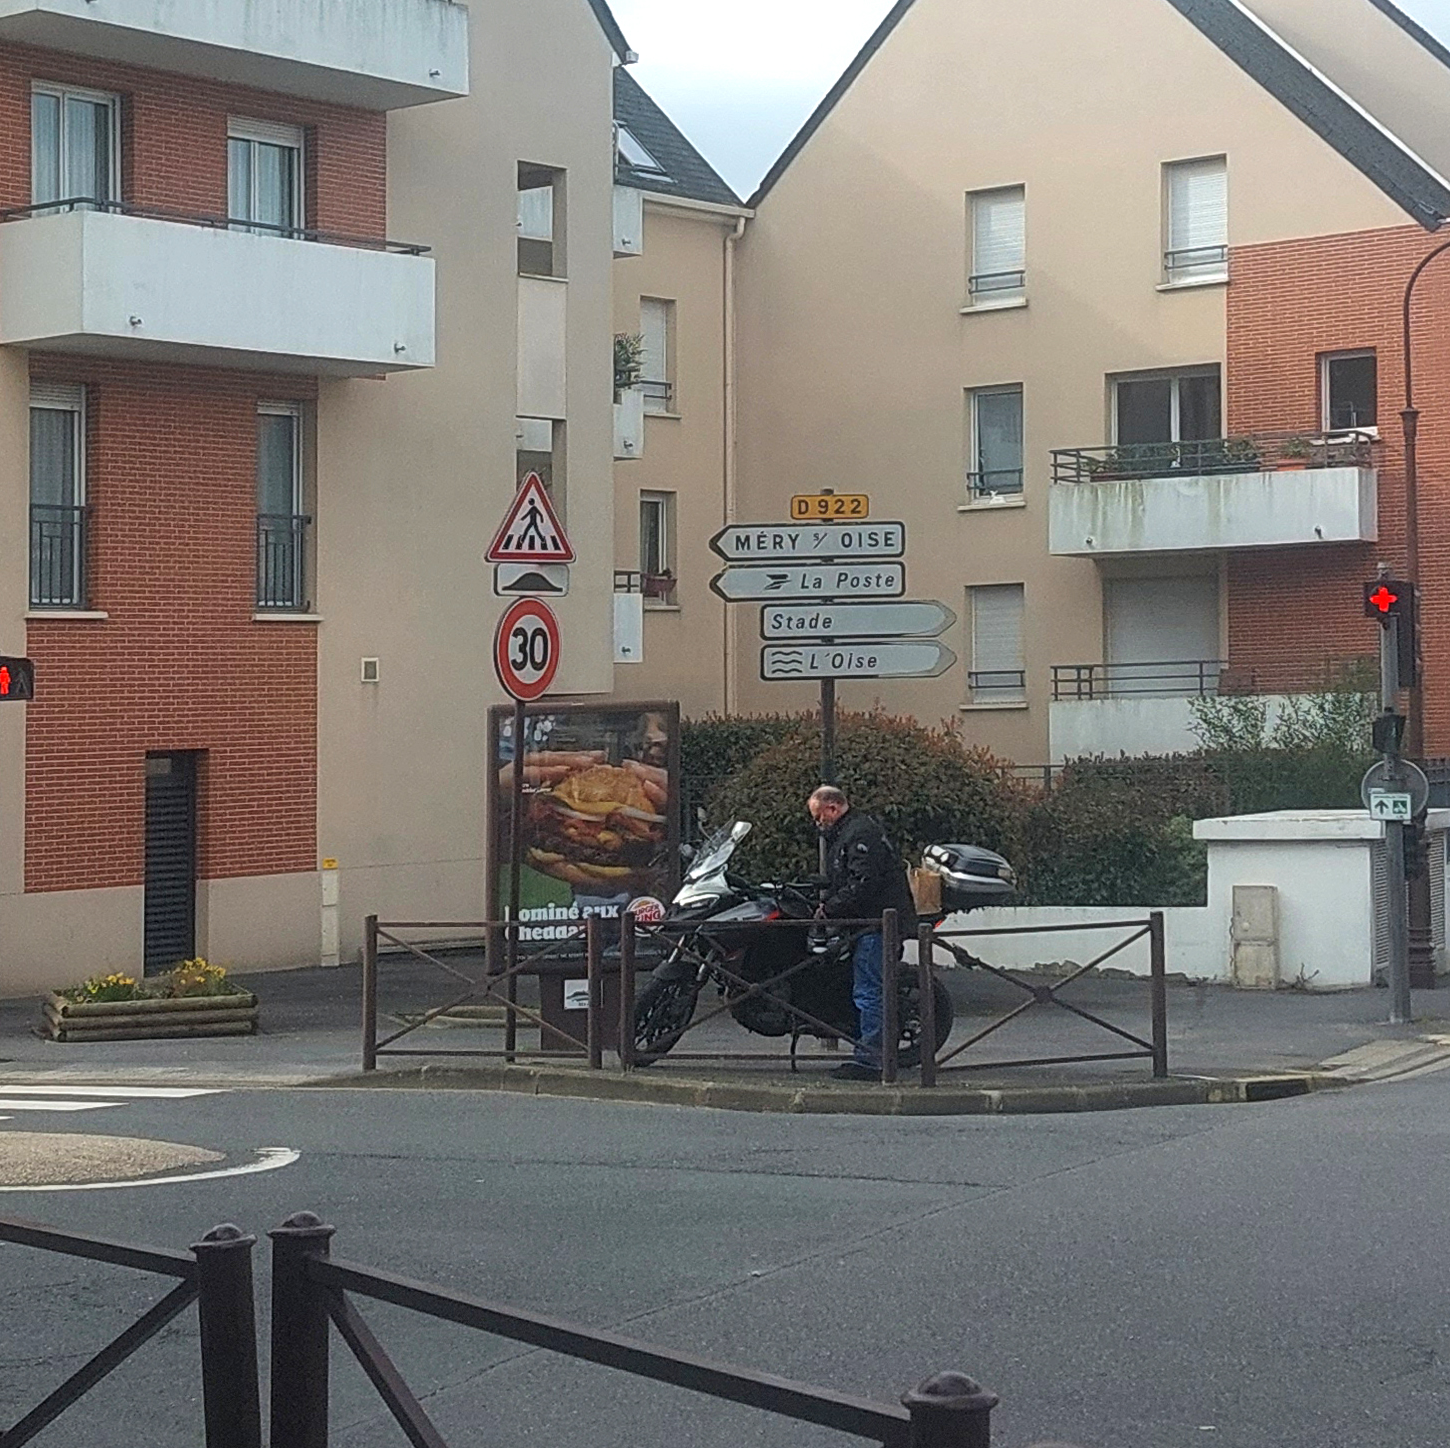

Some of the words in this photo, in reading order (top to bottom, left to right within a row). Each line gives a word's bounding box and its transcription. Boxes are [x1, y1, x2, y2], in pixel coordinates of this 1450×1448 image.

[797, 499, 809, 515] D
[818, 498, 862, 515] 922
[735, 531, 800, 551] MÉRY
[841, 531, 896, 549] OISE
[801, 573, 823, 589] La
[836, 572, 895, 589] Poste
[771, 612, 833, 630] Stade
[511, 626, 549, 672] 30
[809, 652, 878, 670] L'Oise
